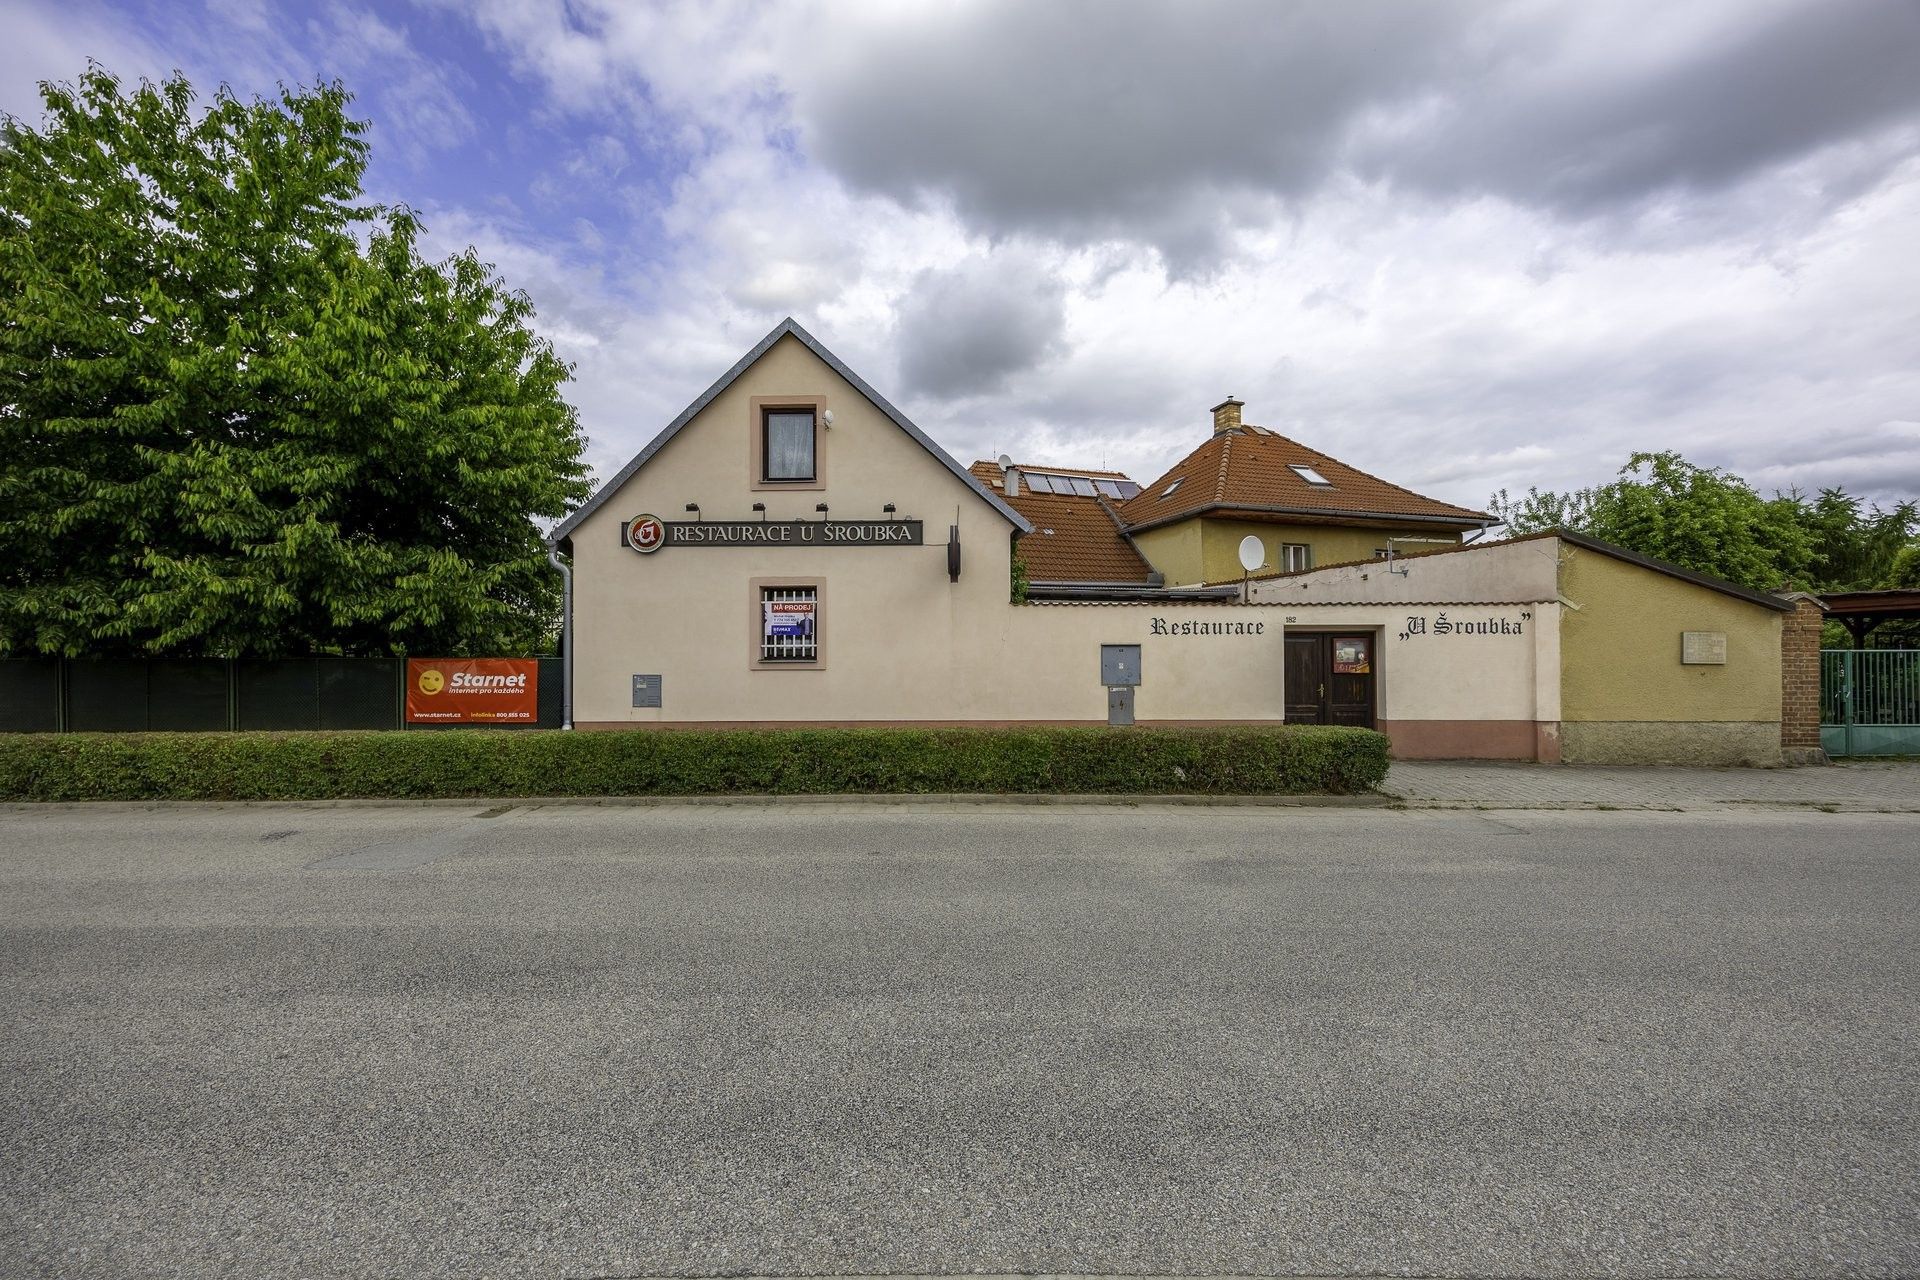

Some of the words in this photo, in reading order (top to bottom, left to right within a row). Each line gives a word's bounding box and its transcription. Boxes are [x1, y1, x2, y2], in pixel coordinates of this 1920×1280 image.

[673, 525, 791, 542] RESTAURACE
[801, 525, 815, 542] U
[824, 522, 912, 541] ŠROUBKA
[1150, 617, 1265, 636] Restaurace
[450, 672, 527, 687] Starnet
